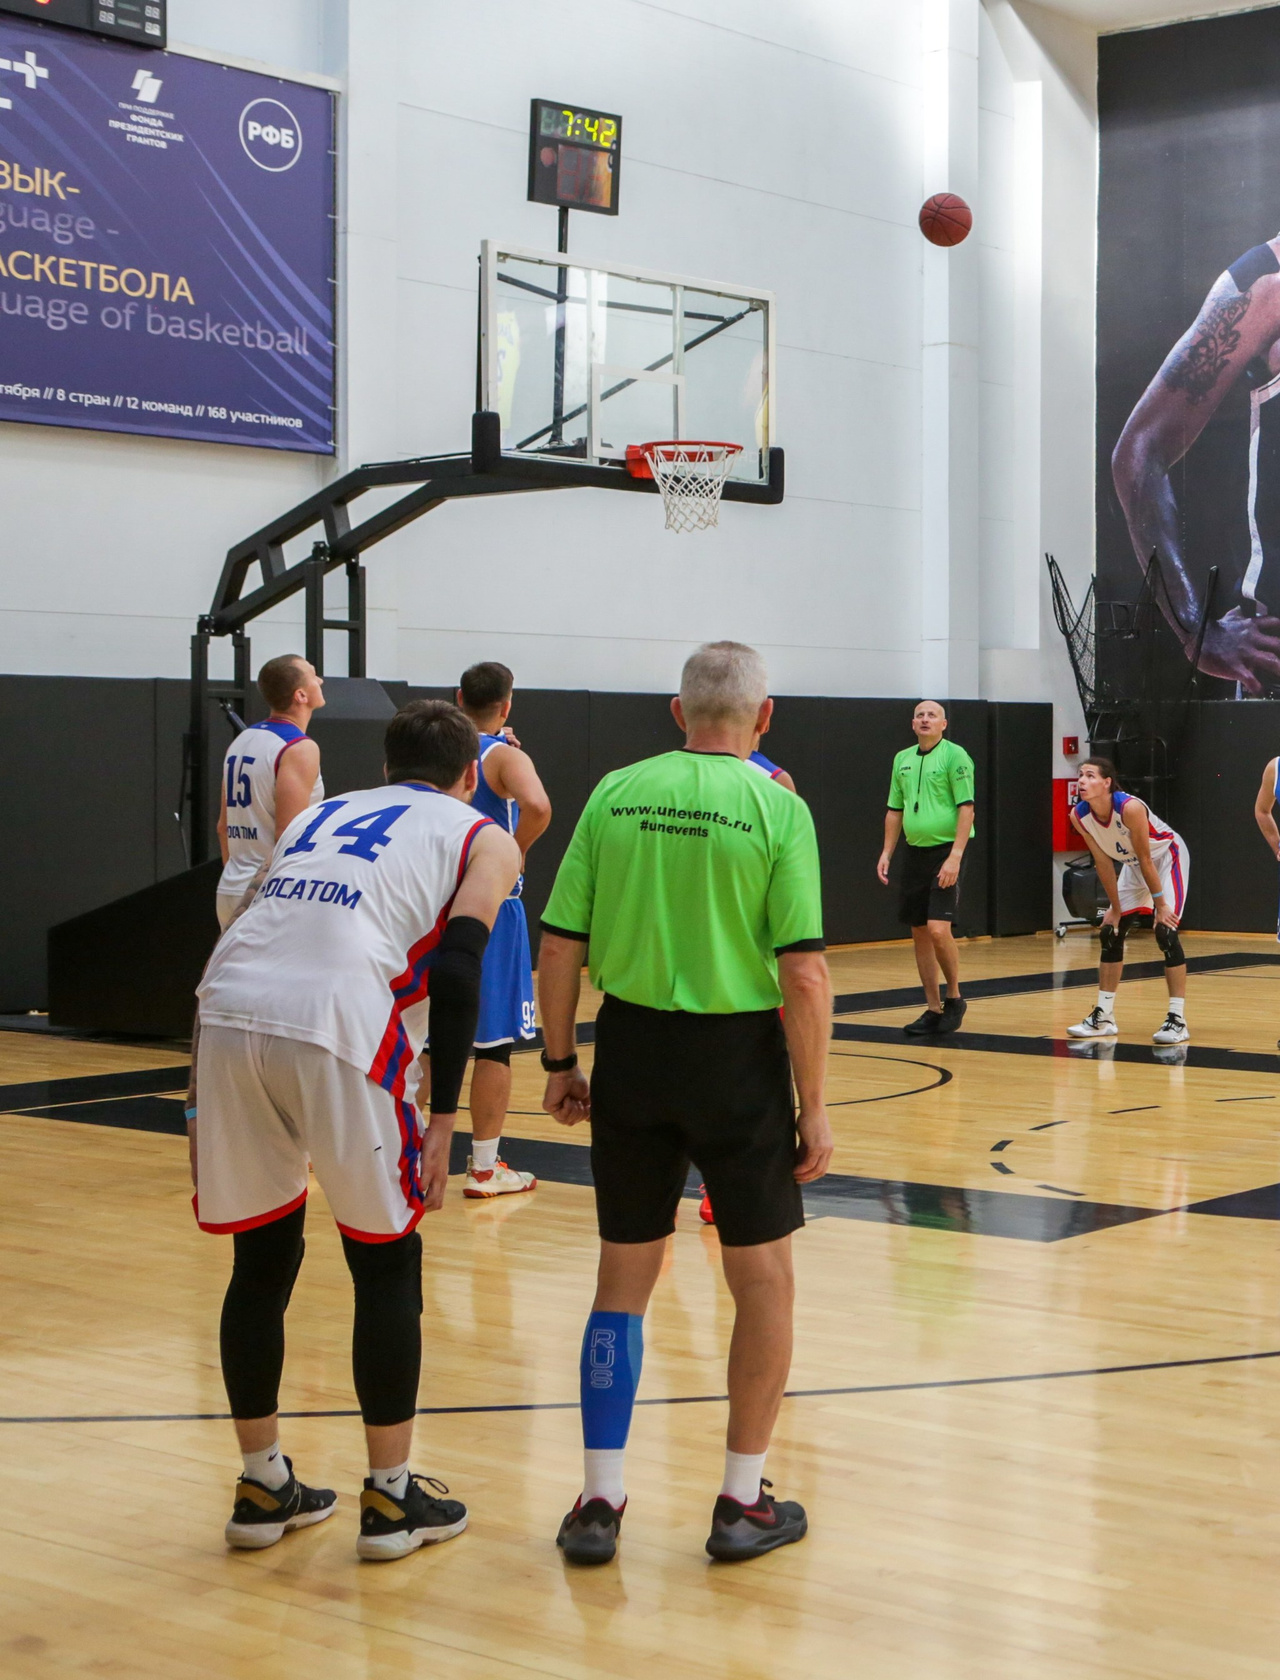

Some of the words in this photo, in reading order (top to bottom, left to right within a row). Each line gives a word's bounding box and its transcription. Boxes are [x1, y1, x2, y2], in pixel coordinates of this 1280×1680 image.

[126, 133, 168, 149] ГРАНТОВ
[247, 120, 295, 149] РФБ
[562, 110, 616, 148] 7:42
[99, 302, 138, 331] of
[146, 306, 310, 356] basketball
[56, 388, 66, 401] 8
[68, 392, 111, 407] стран
[126, 396, 139, 410] 12
[141, 400, 193, 417] команд
[207, 405, 227, 420] 168
[229, 410, 303, 429] участников
[226, 755, 256, 808] 15
[283, 800, 411, 864] 14
[611, 804, 753, 834] www.unevents.ru
[640, 819, 709, 838] #unevents
[1115, 841, 1130, 856] 4
[254, 877, 363, 910] ОСАТОМ
[590, 1328, 616, 1389] RUS
